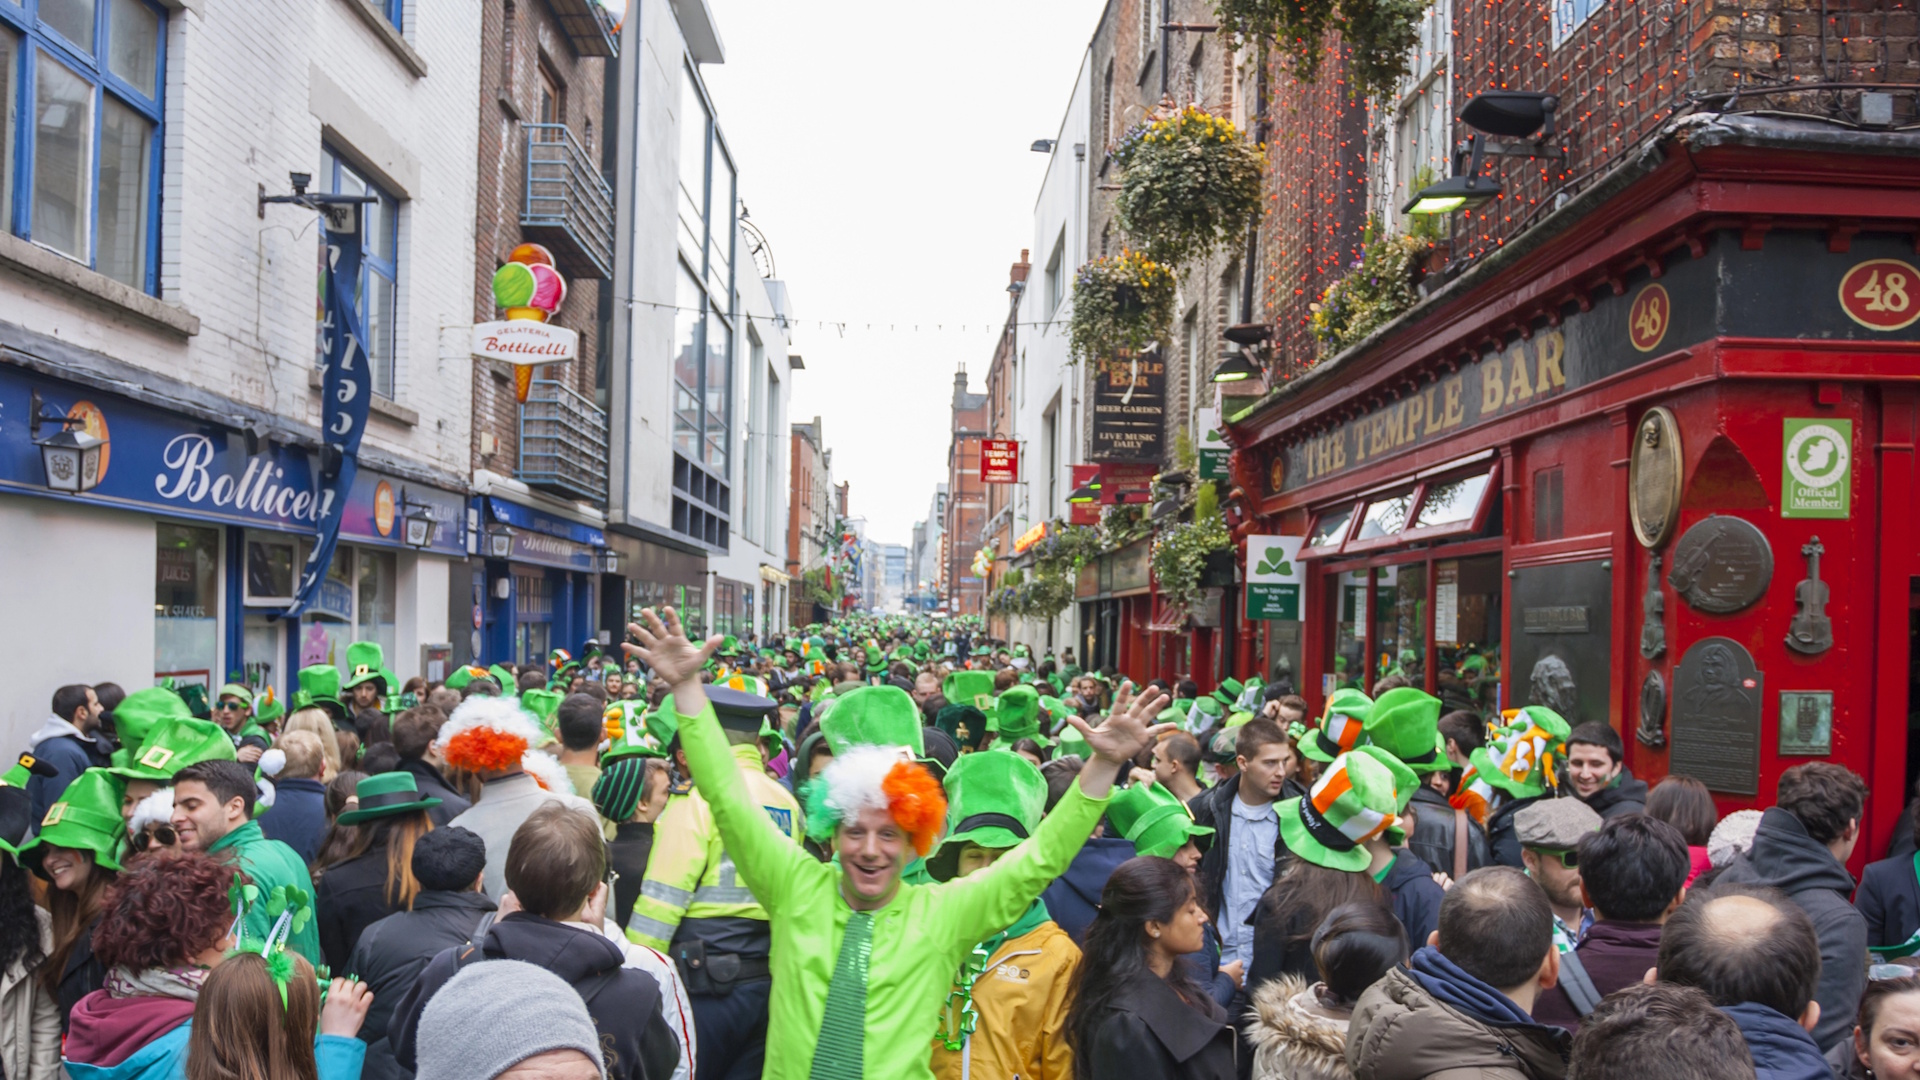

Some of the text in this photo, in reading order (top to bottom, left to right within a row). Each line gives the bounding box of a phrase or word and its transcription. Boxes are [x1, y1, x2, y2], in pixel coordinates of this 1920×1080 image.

[1854, 269, 1910, 312] 48
[1635, 297, 1662, 340] 48
[497, 327, 551, 338] GELATERIA
[481, 336, 568, 356] Botticelli
[1095, 405, 1163, 415] BEER GARDEN
[1303, 331, 1567, 480] THE TEMPLE BAR
[1099, 432, 1157, 442] LIVE MUSIC
[992, 441, 1008, 450] THE
[1113, 440, 1143, 448] DAILY
[984, 450, 1016, 459] TEMPLE
[990, 458, 1009, 467] BAR
[1797, 487, 1837, 497] Official
[1795, 497, 1840, 508] Member
